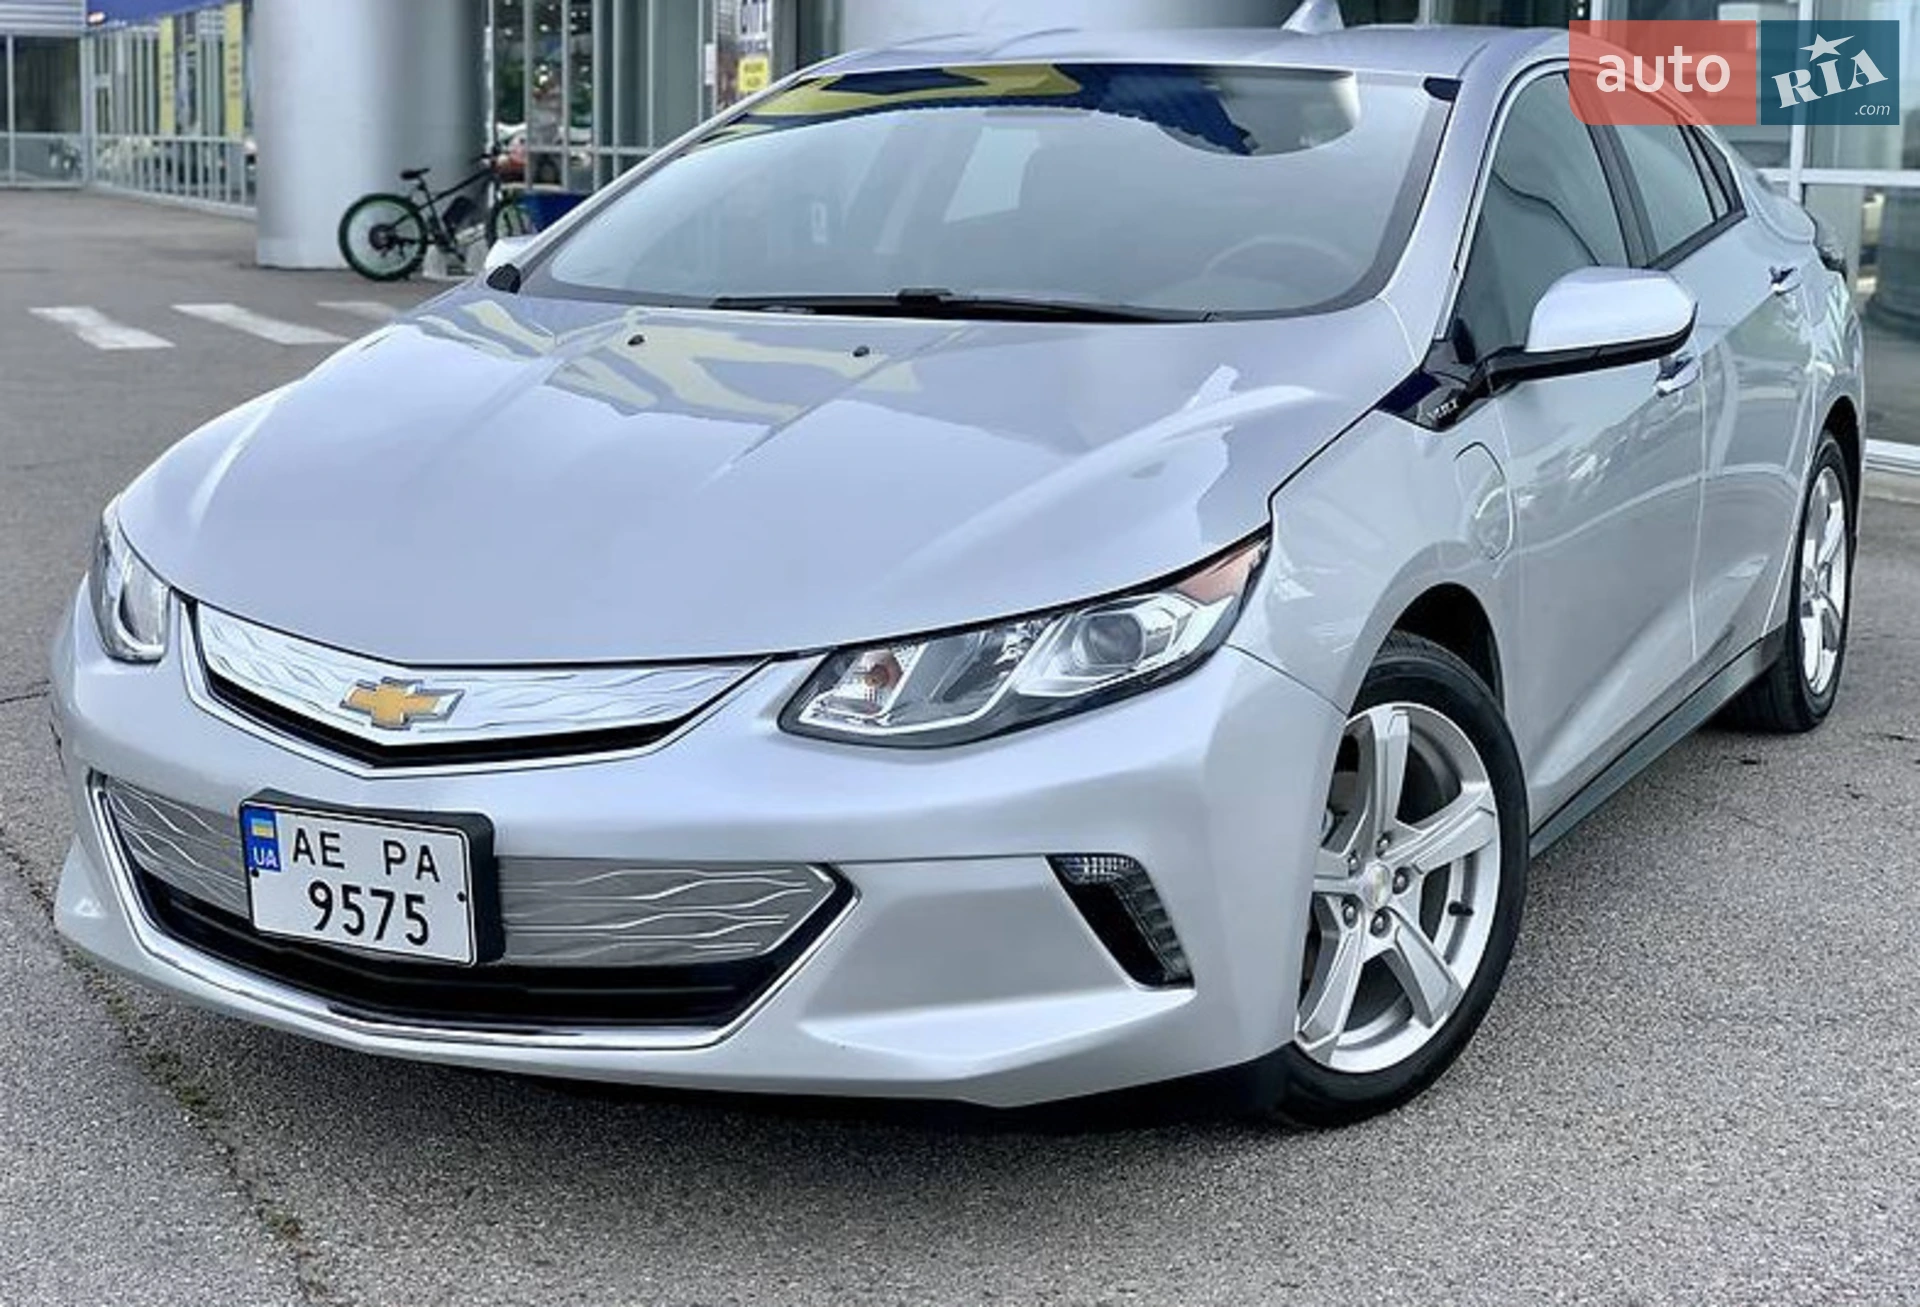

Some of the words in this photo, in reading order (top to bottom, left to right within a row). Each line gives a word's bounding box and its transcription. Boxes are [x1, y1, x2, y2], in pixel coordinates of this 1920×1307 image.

[253, 847, 278, 868] UA
[293, 828, 345, 870] AE
[383, 840, 440, 883] PA
[308, 880, 429, 946] 9575
